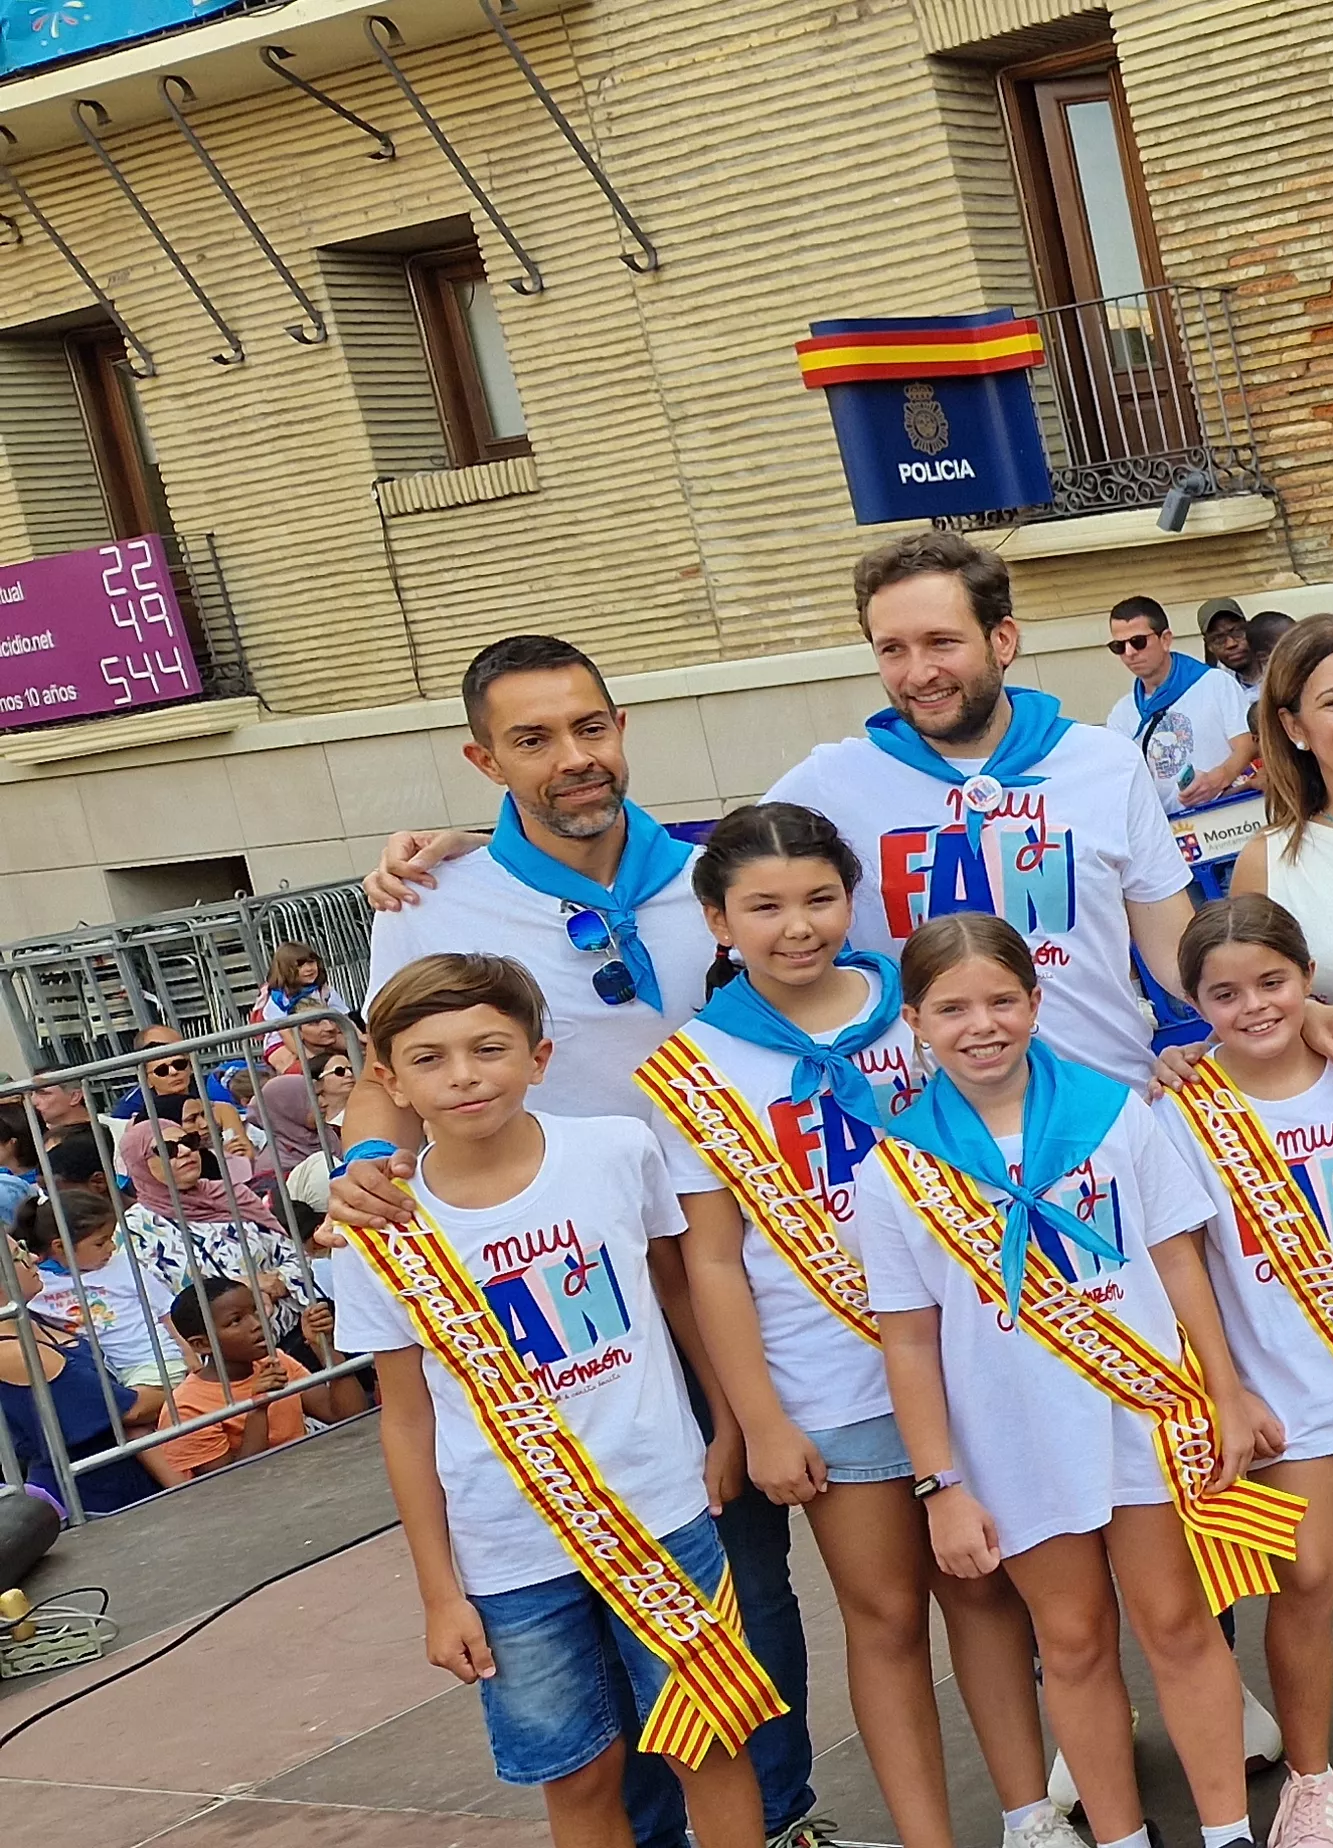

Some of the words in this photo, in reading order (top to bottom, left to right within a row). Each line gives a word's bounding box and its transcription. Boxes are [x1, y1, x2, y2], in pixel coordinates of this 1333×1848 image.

[898, 459, 975, 484] POLICIA
[0, 580, 24, 605] tual
[99, 540, 157, 597] 22
[0, 629, 56, 658] cidio.net
[110, 592, 174, 643] 49
[24, 687, 40, 708] 10
[41, 684, 77, 704] años
[100, 646, 189, 706] 544
[1203, 819, 1262, 844] Monzón
[880, 824, 1077, 939] FAN
[668, 1062, 807, 1239] Zagaleta
[1194, 1087, 1305, 1256] Zagaleta
[483, 1219, 599, 1297] muy
[1031, 1278, 1184, 1408] Monzón
[493, 1381, 620, 1560] Monzón
[618, 1560, 722, 1643] 2025
